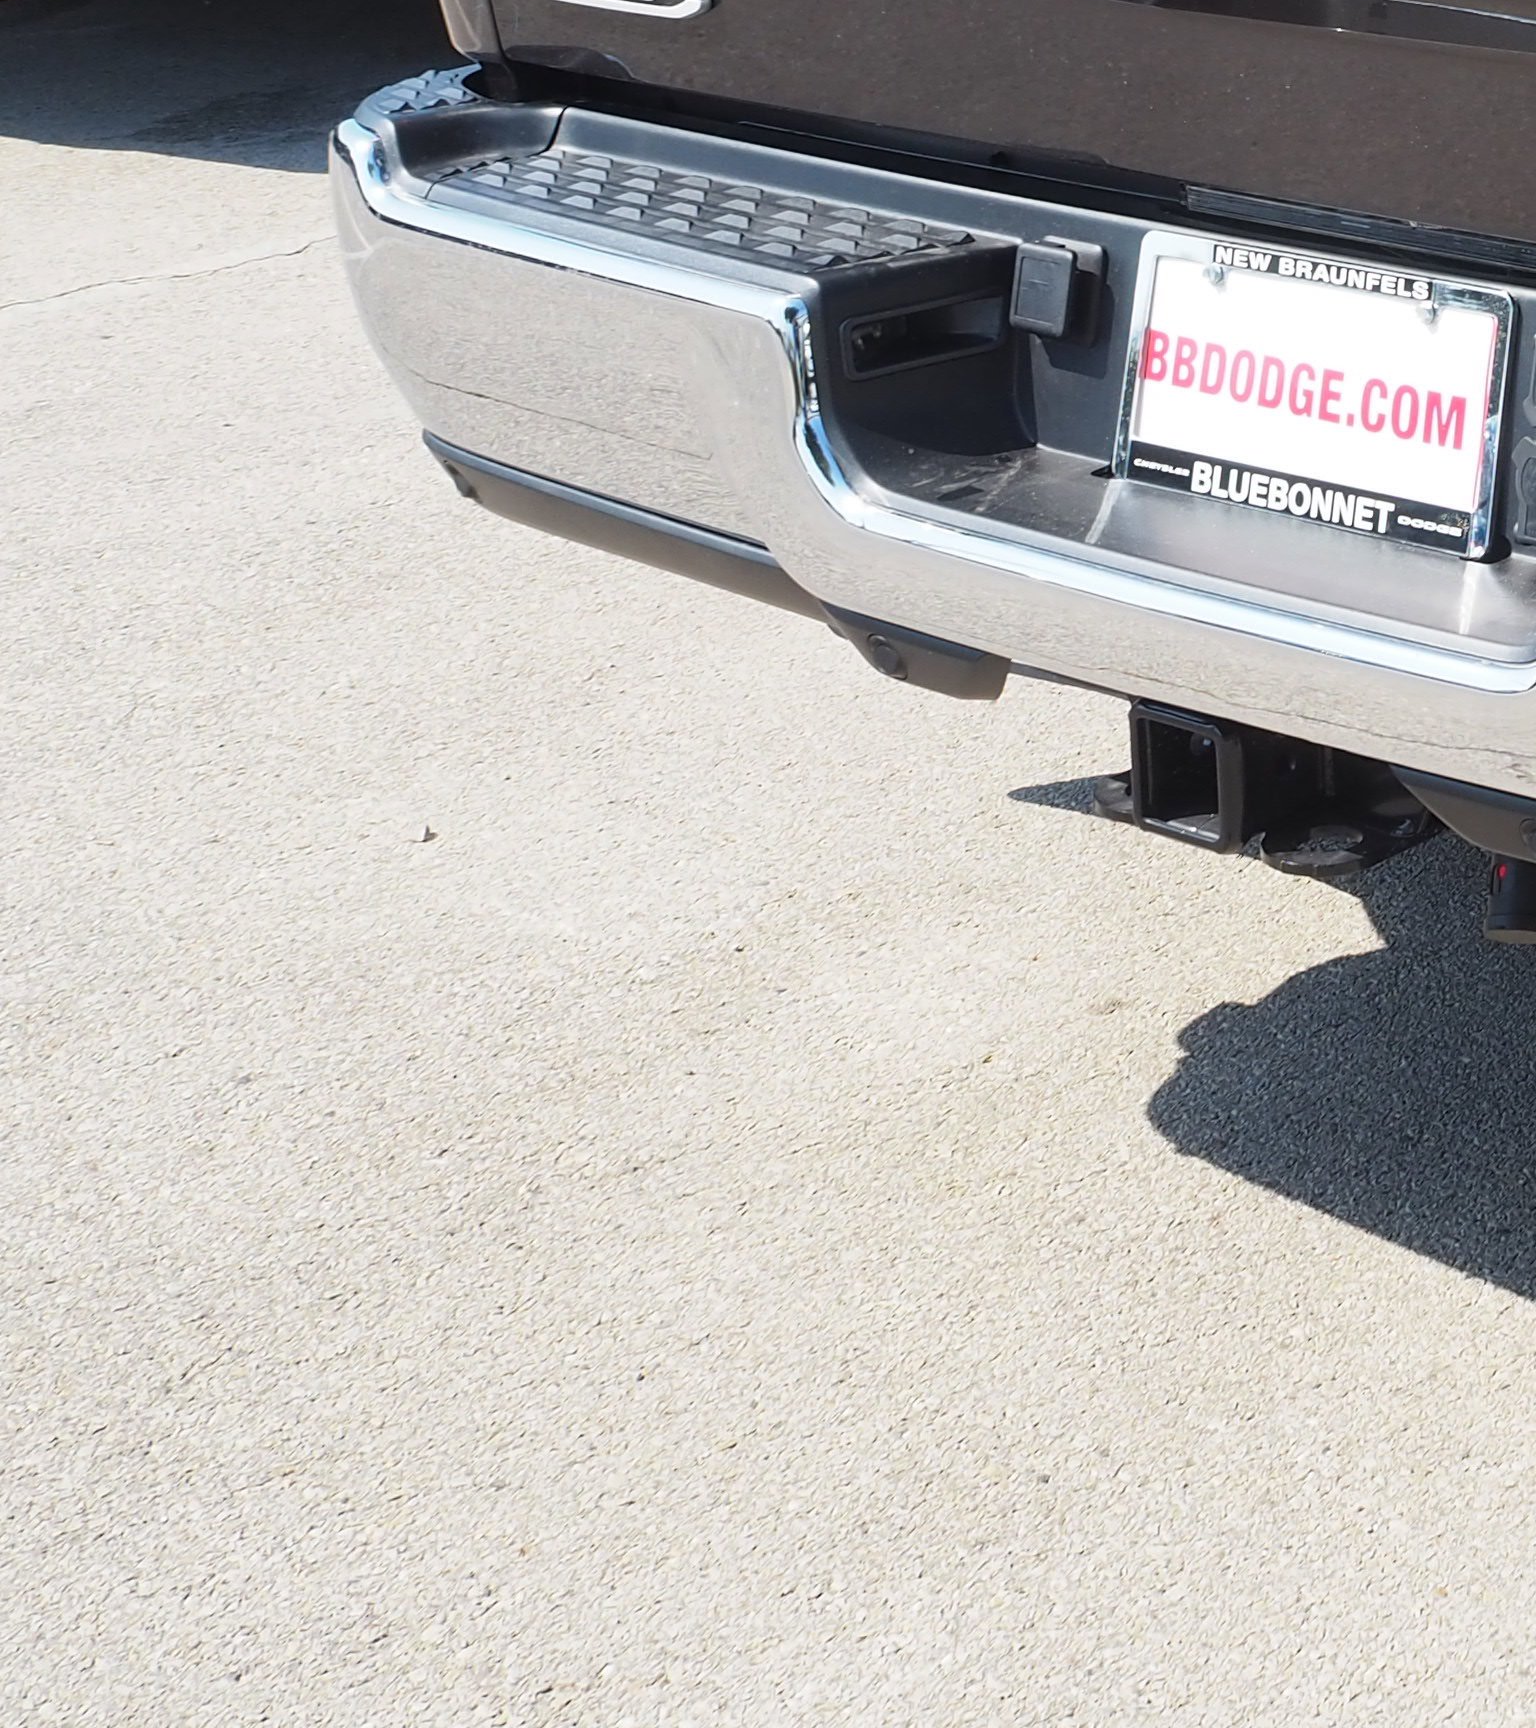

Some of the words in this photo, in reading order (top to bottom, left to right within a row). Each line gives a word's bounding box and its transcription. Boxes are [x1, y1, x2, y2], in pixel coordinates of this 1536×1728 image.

[1215, 245, 1272, 272] NEW
[1278, 256, 1431, 301] BRAUNFELS
[1143, 329, 1467, 450] BBDODGE.COM
[1190, 460, 1395, 534] BLUEBONNET
